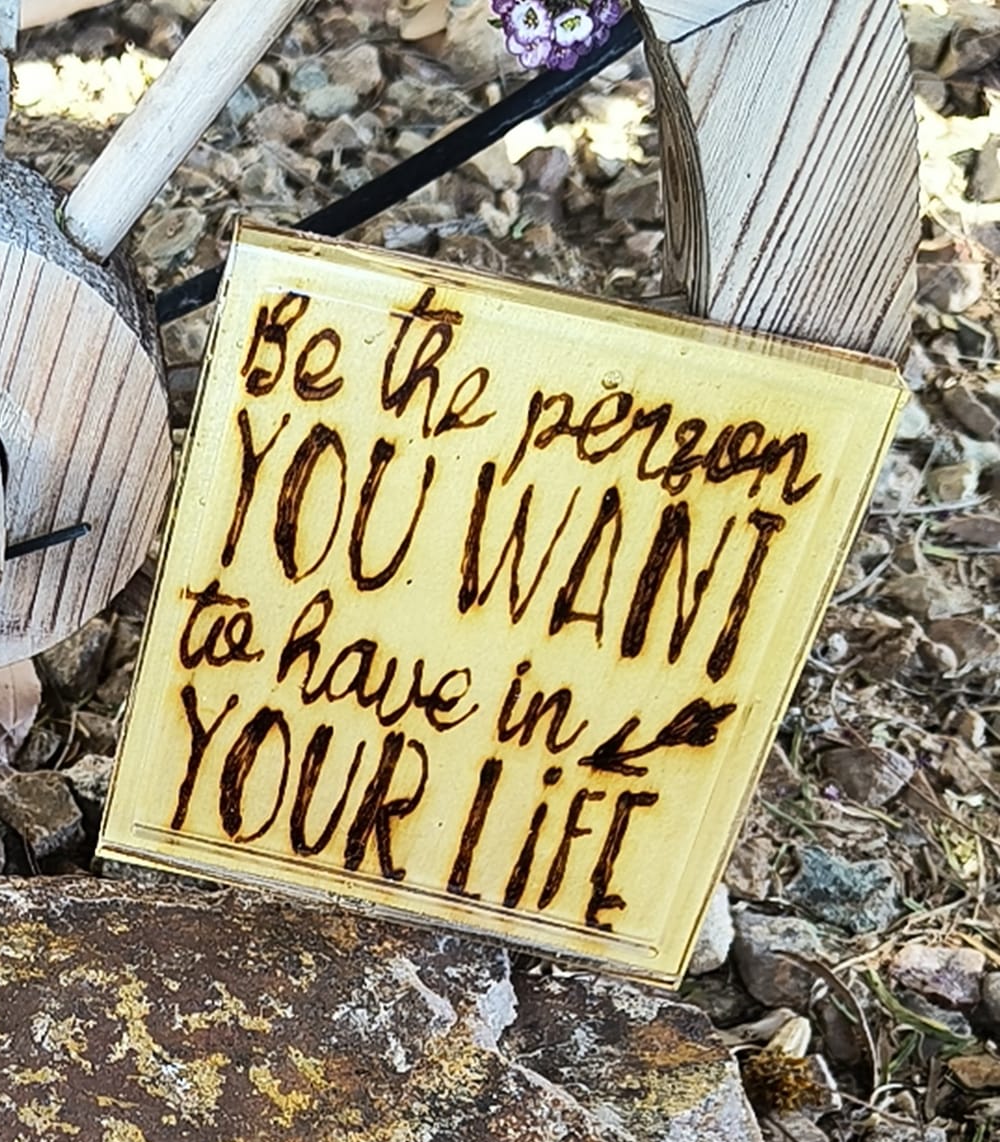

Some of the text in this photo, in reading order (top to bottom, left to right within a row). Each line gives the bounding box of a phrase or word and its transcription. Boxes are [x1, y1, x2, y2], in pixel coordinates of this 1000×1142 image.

[240, 287, 822, 505] Be the person
[221, 408, 786, 682] YOU WANT
[178, 578, 589, 750] to have in
[170, 685, 428, 880] YOUR
